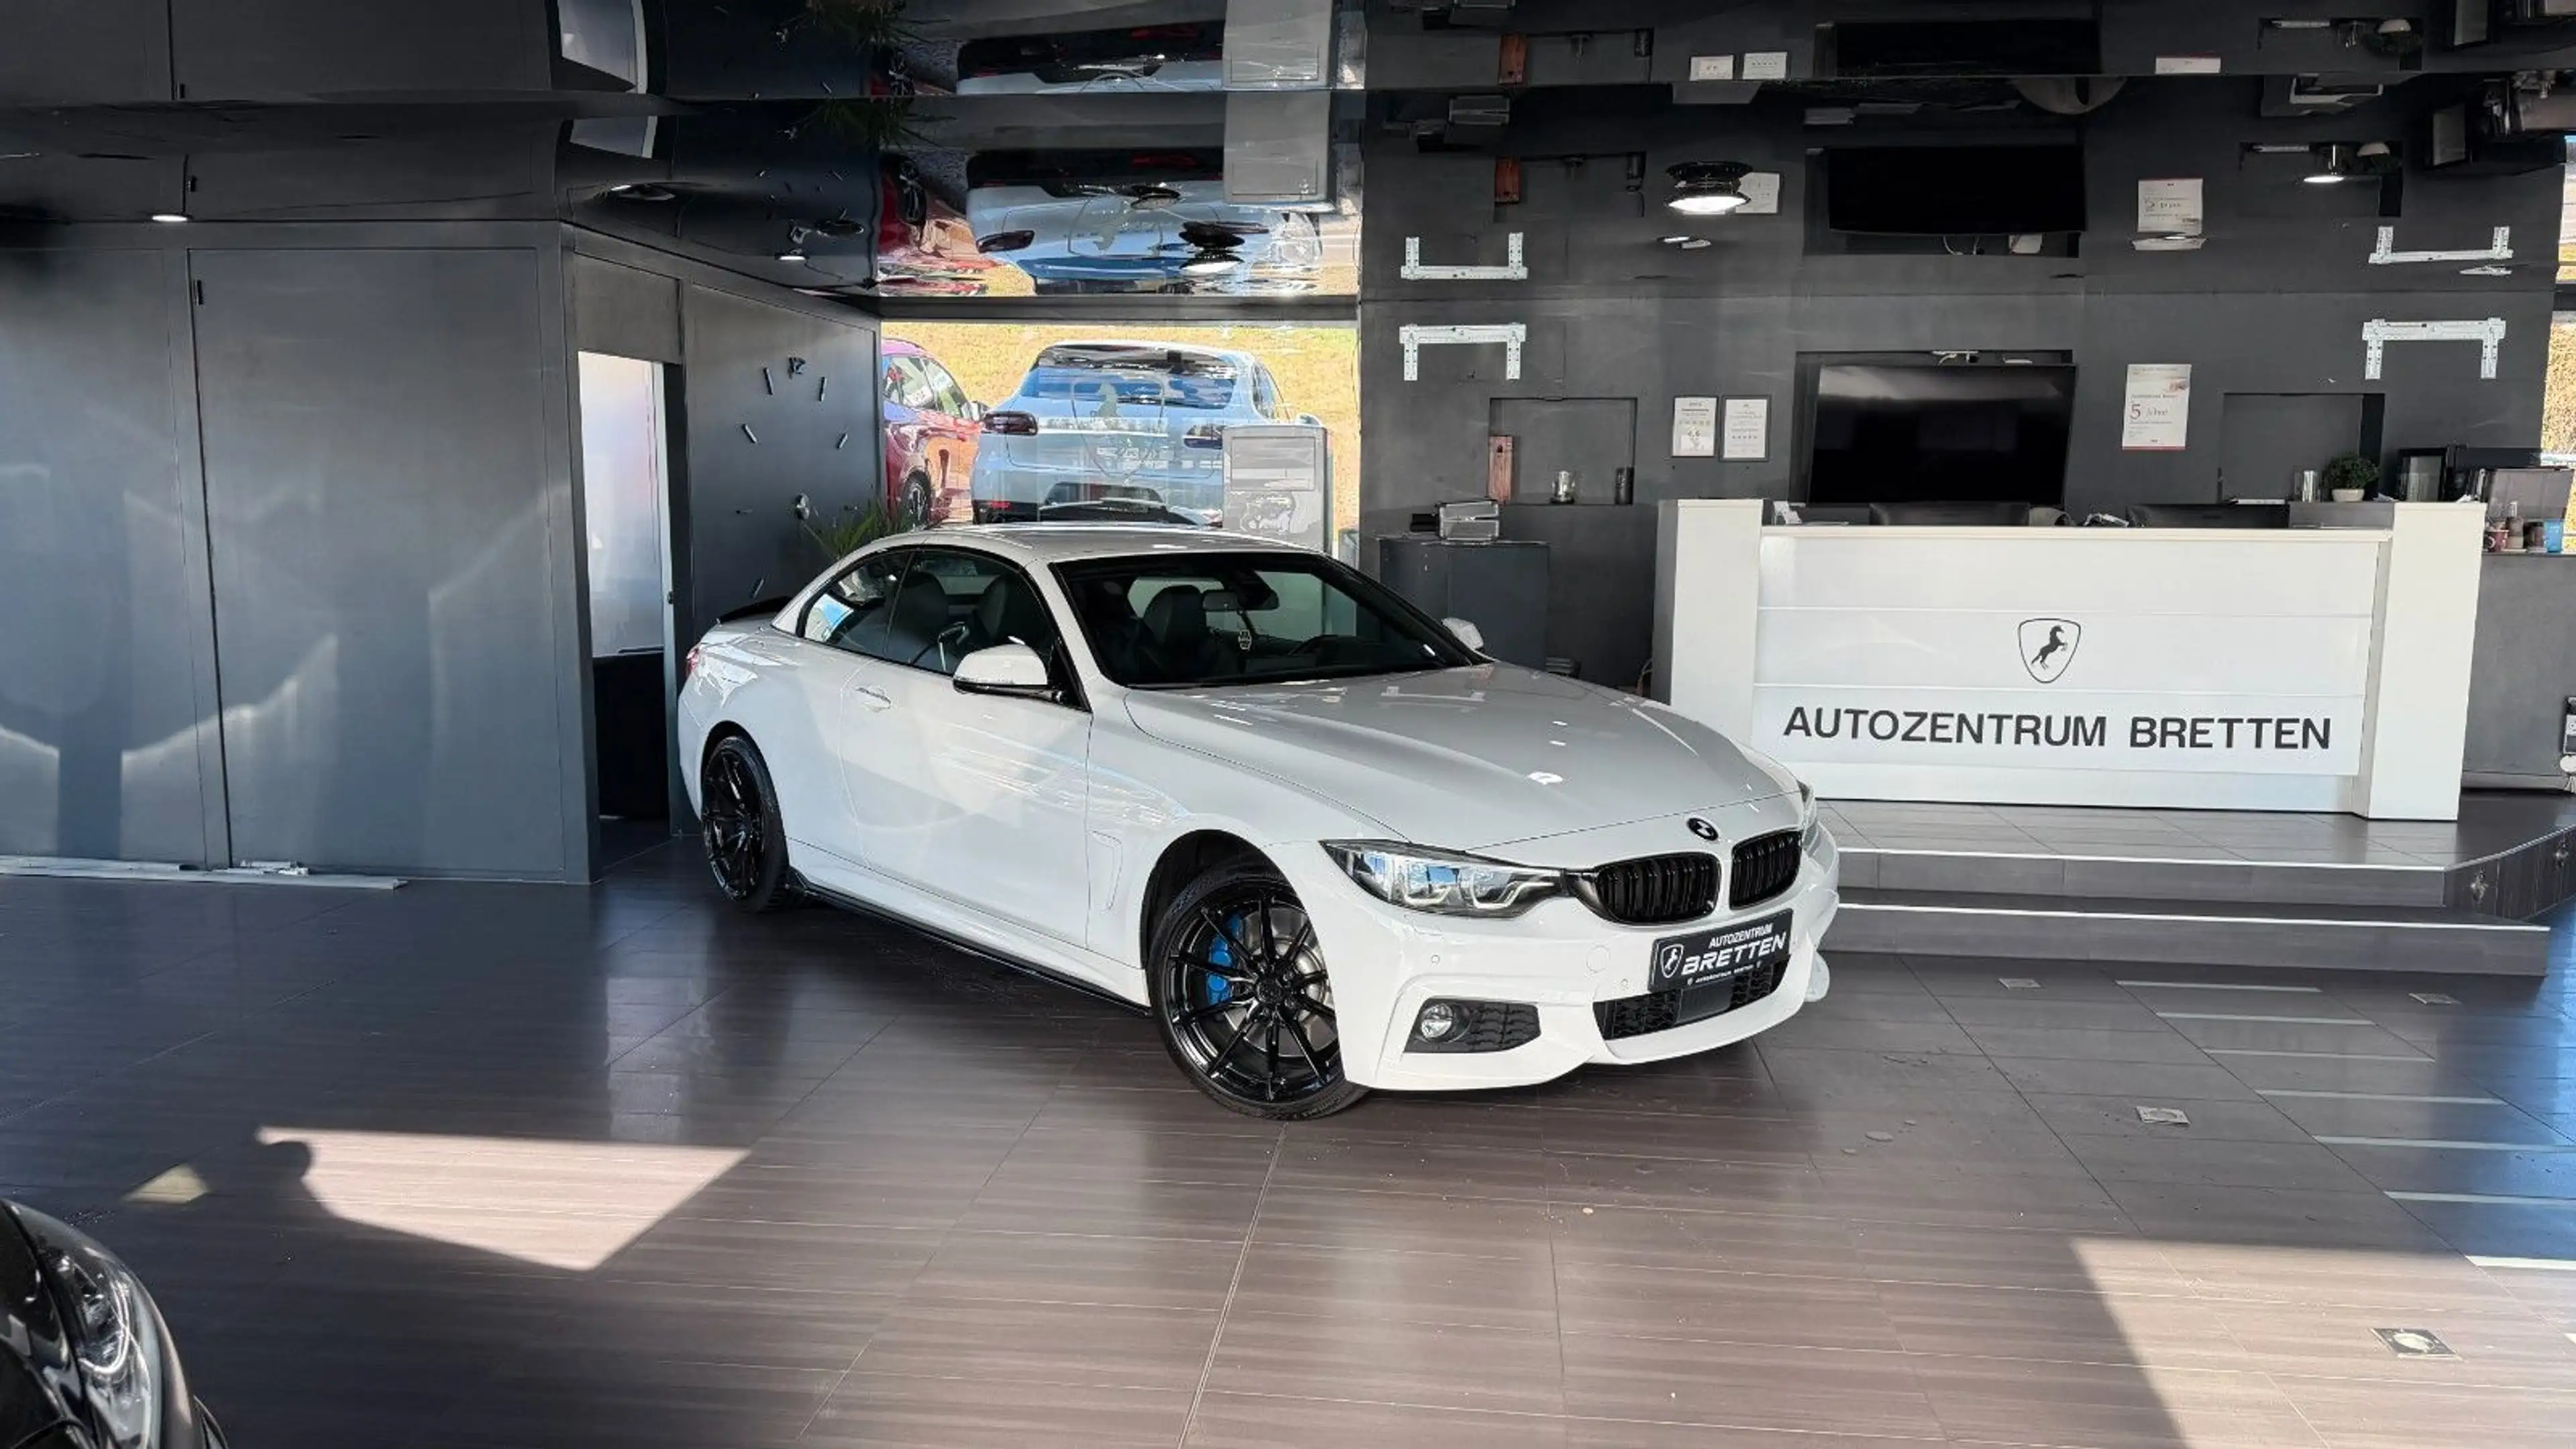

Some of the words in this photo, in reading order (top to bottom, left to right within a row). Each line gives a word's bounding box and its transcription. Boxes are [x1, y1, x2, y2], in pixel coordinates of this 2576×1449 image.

[1783, 706, 2106, 747] AUTOZENTRUM
[2129, 716, 2331, 750] BRETTEN
[1682, 932, 1786, 975] BRETTEN
[1709, 923, 1773, 949] AUTOZENTRUM
